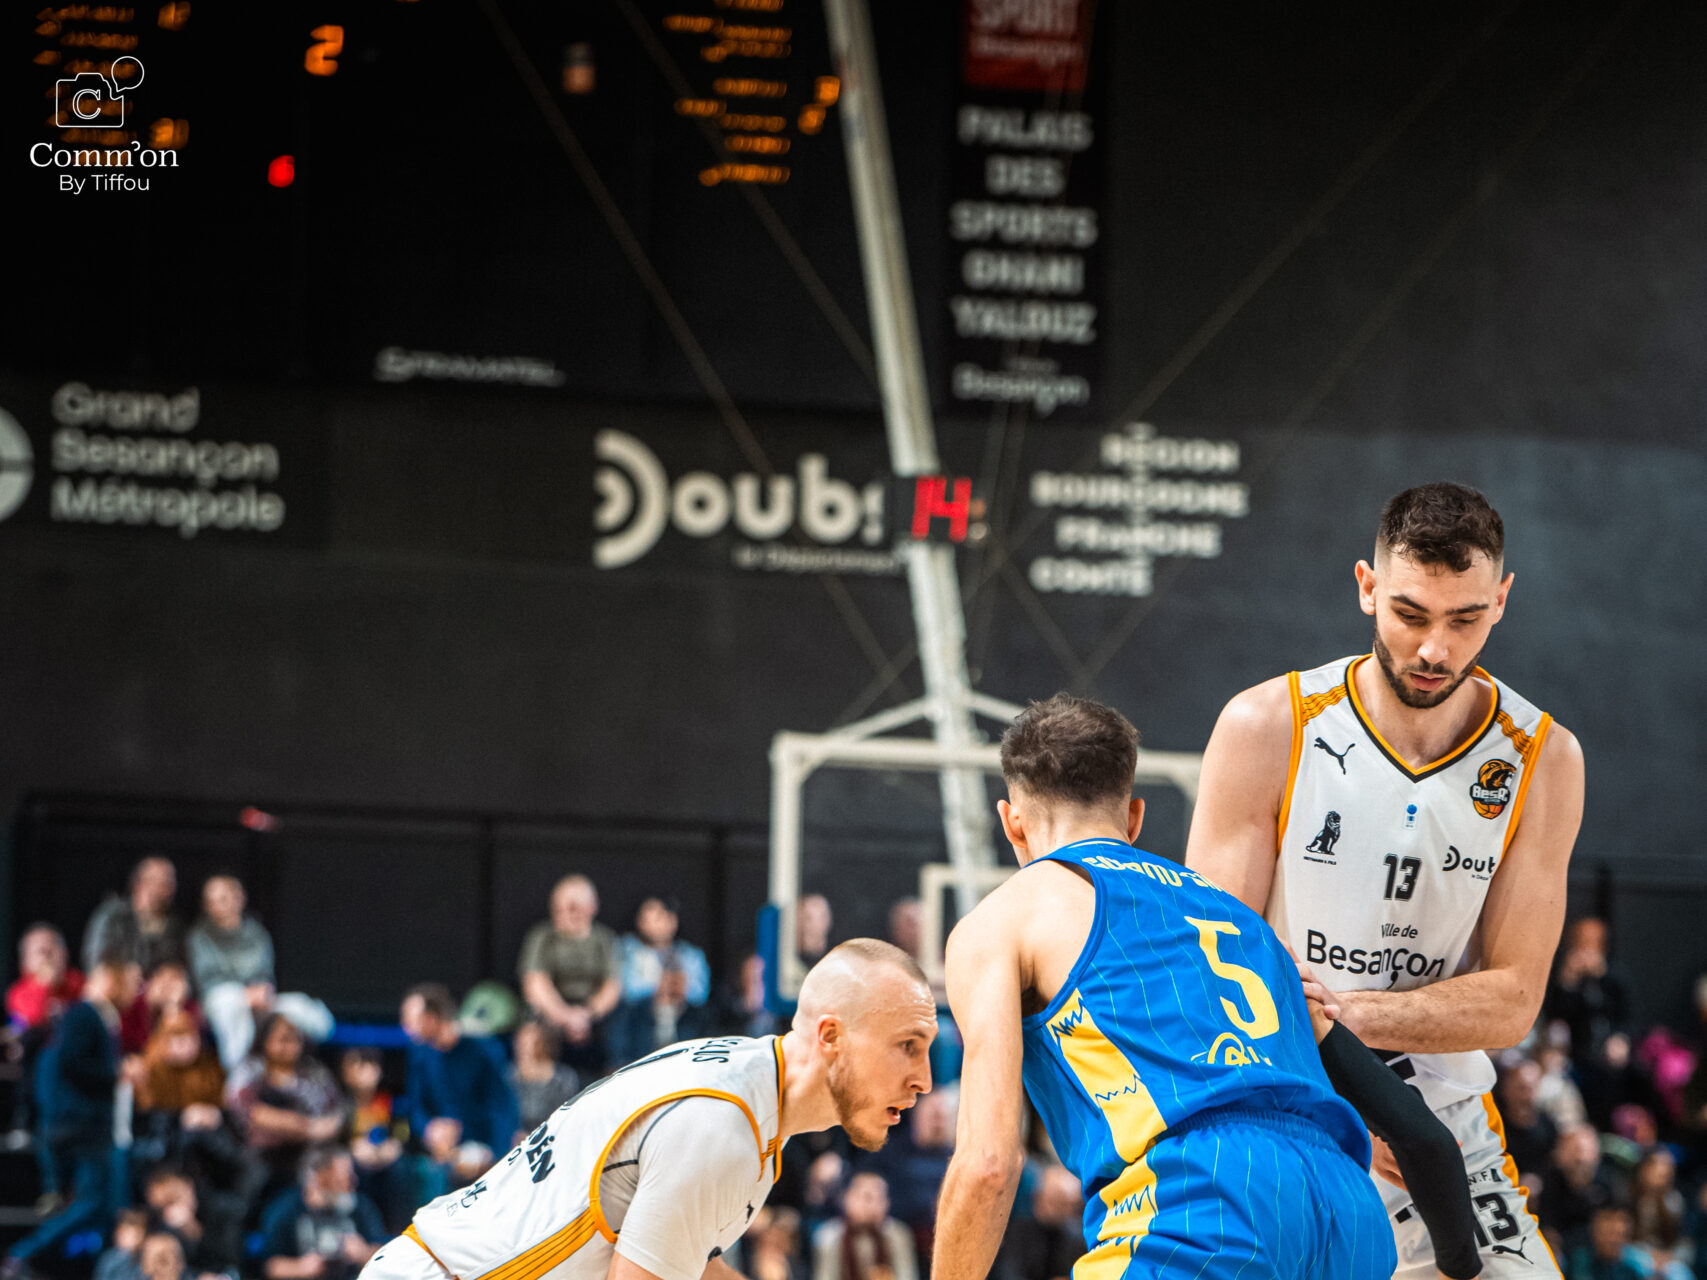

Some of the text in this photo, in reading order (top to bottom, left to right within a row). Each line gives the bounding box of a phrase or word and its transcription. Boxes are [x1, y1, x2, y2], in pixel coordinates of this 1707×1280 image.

[1384, 853, 1422, 902] 13
[1381, 923, 1418, 939] Ville de
[1184, 916, 1280, 1040] 5
[1307, 929, 1446, 990] Besançon
